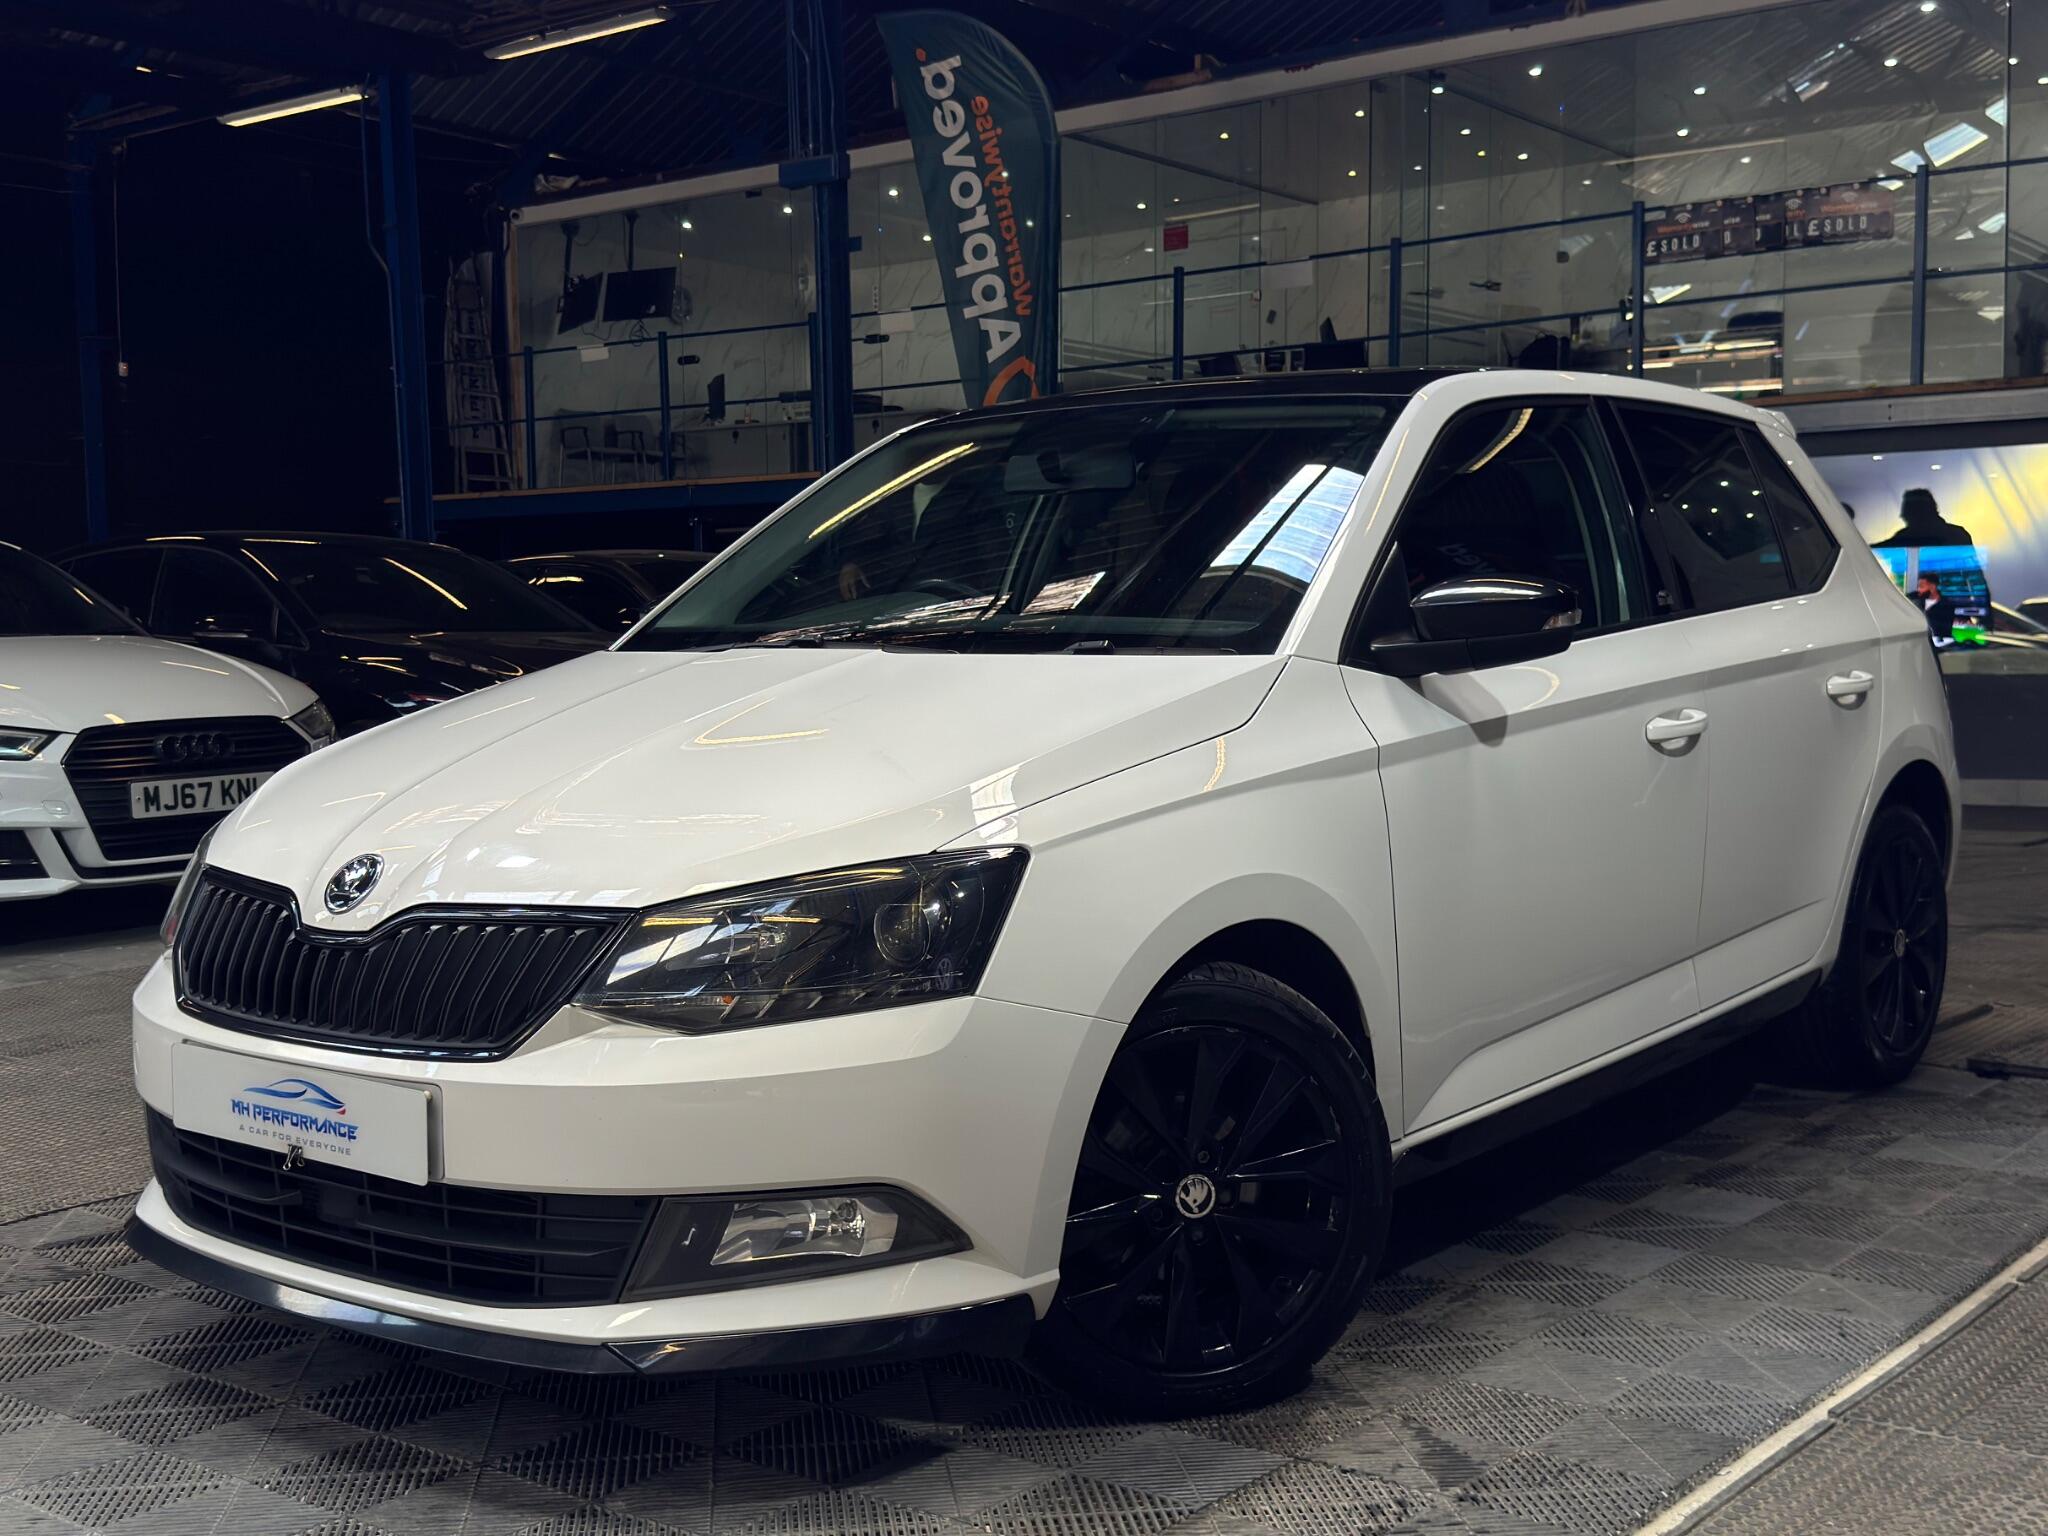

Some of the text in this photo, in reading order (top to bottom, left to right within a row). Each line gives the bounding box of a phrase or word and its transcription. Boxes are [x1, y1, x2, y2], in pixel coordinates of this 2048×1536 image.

[143, 782, 213, 813] MJ67
[231, 1099, 359, 1141] MH PERFORMANCE
[239, 1124, 352, 1156] A CAR FOR EVERYONE
